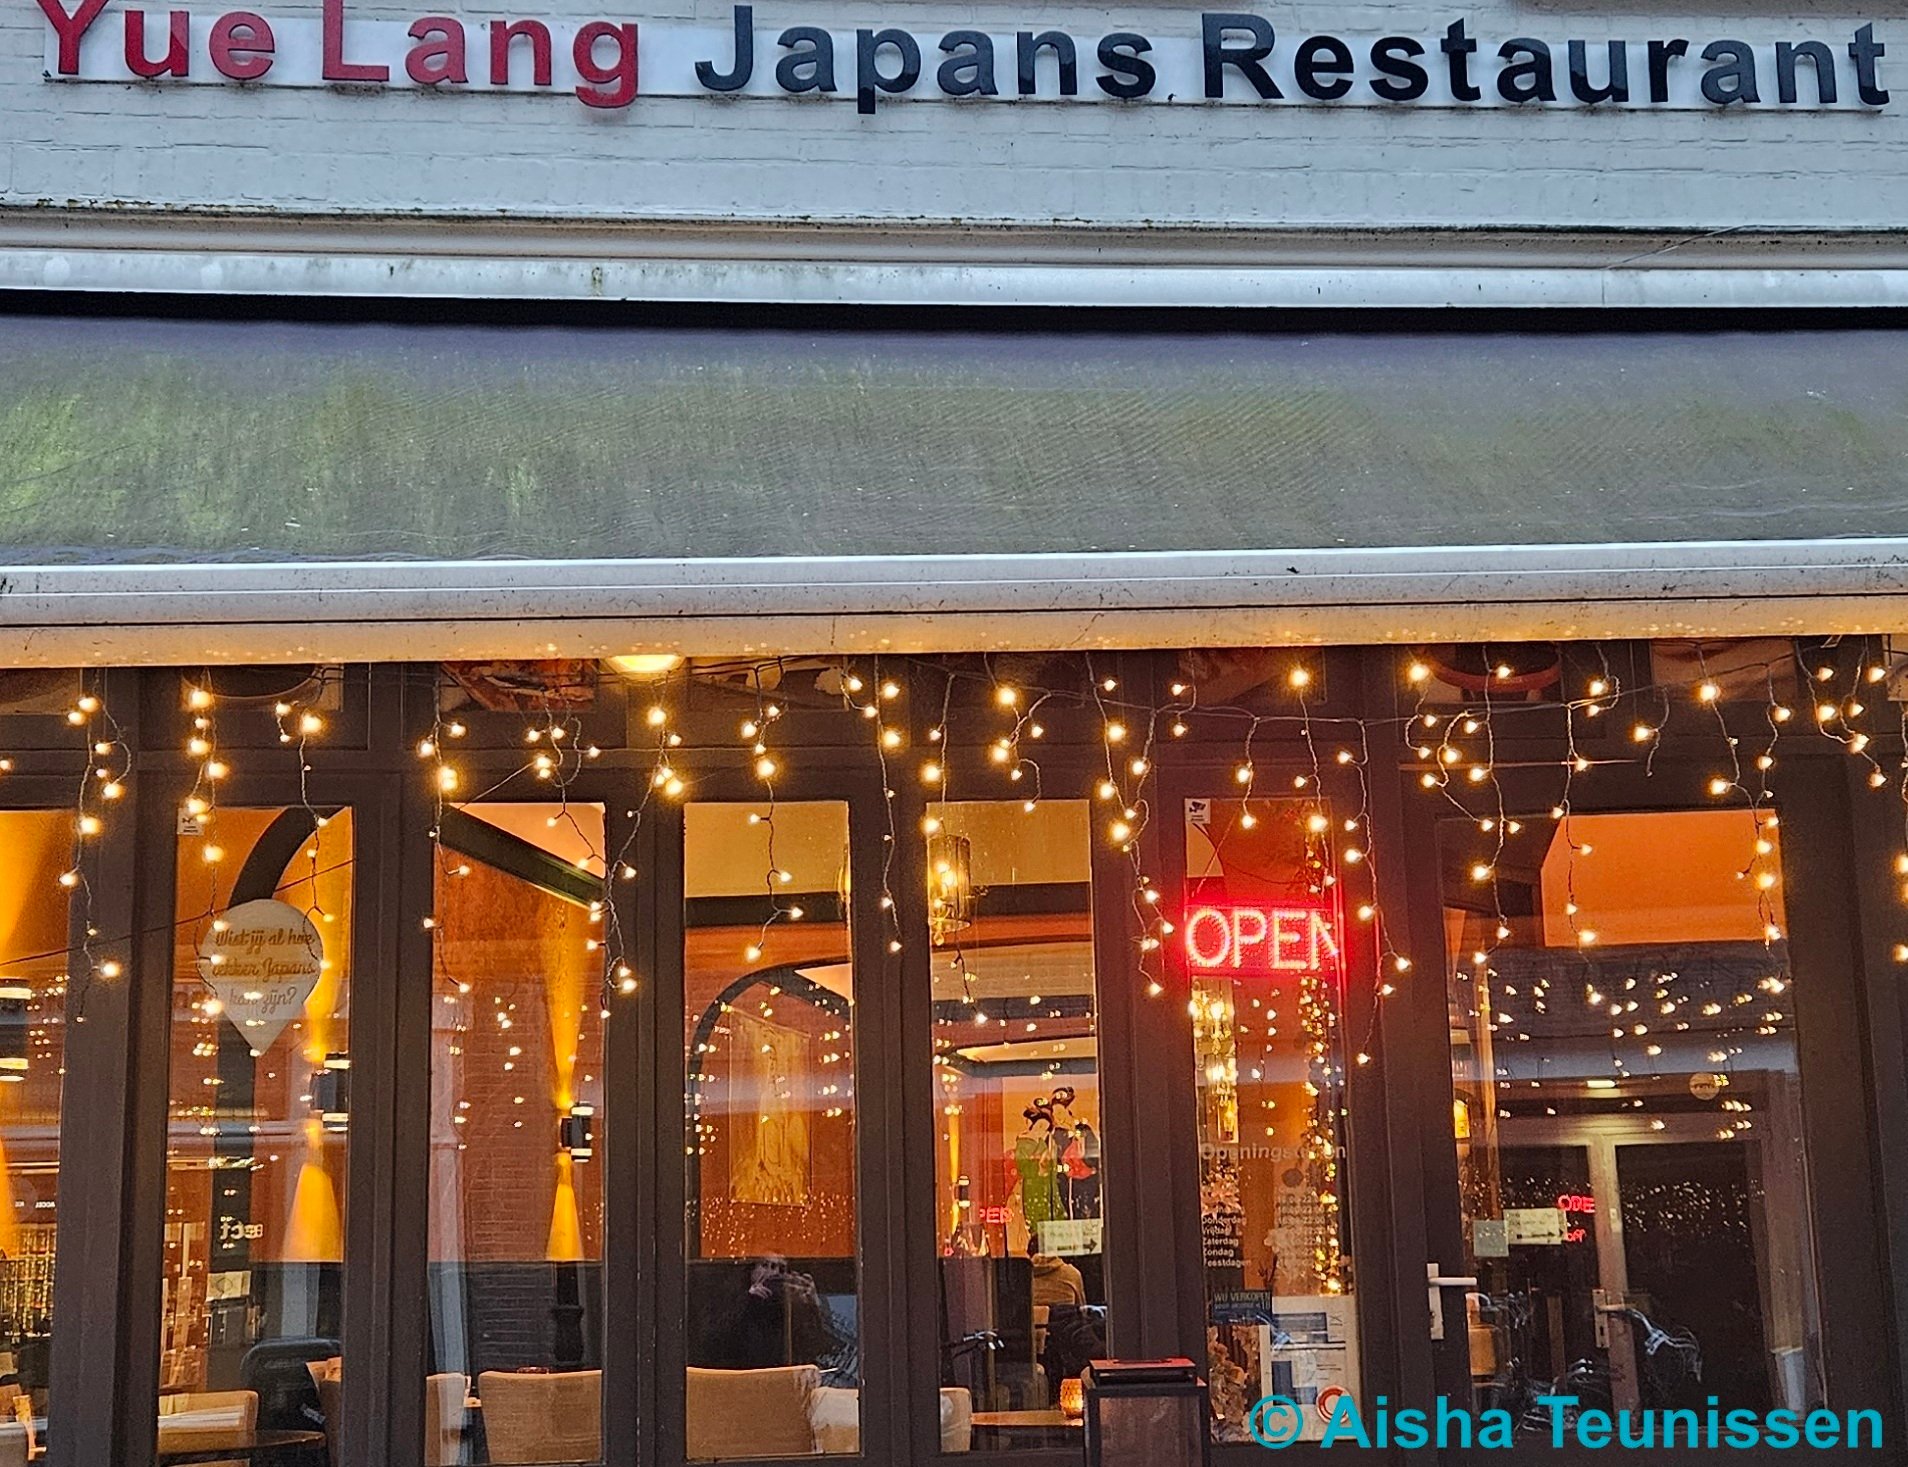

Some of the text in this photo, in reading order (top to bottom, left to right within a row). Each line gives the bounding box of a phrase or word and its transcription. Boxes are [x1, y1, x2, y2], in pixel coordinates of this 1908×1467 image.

[52, 0, 1890, 114] Yue Lang Japans Restaurant
[262, 957, 316, 983] Japans
[1186, 908, 1340, 970] OPEN
